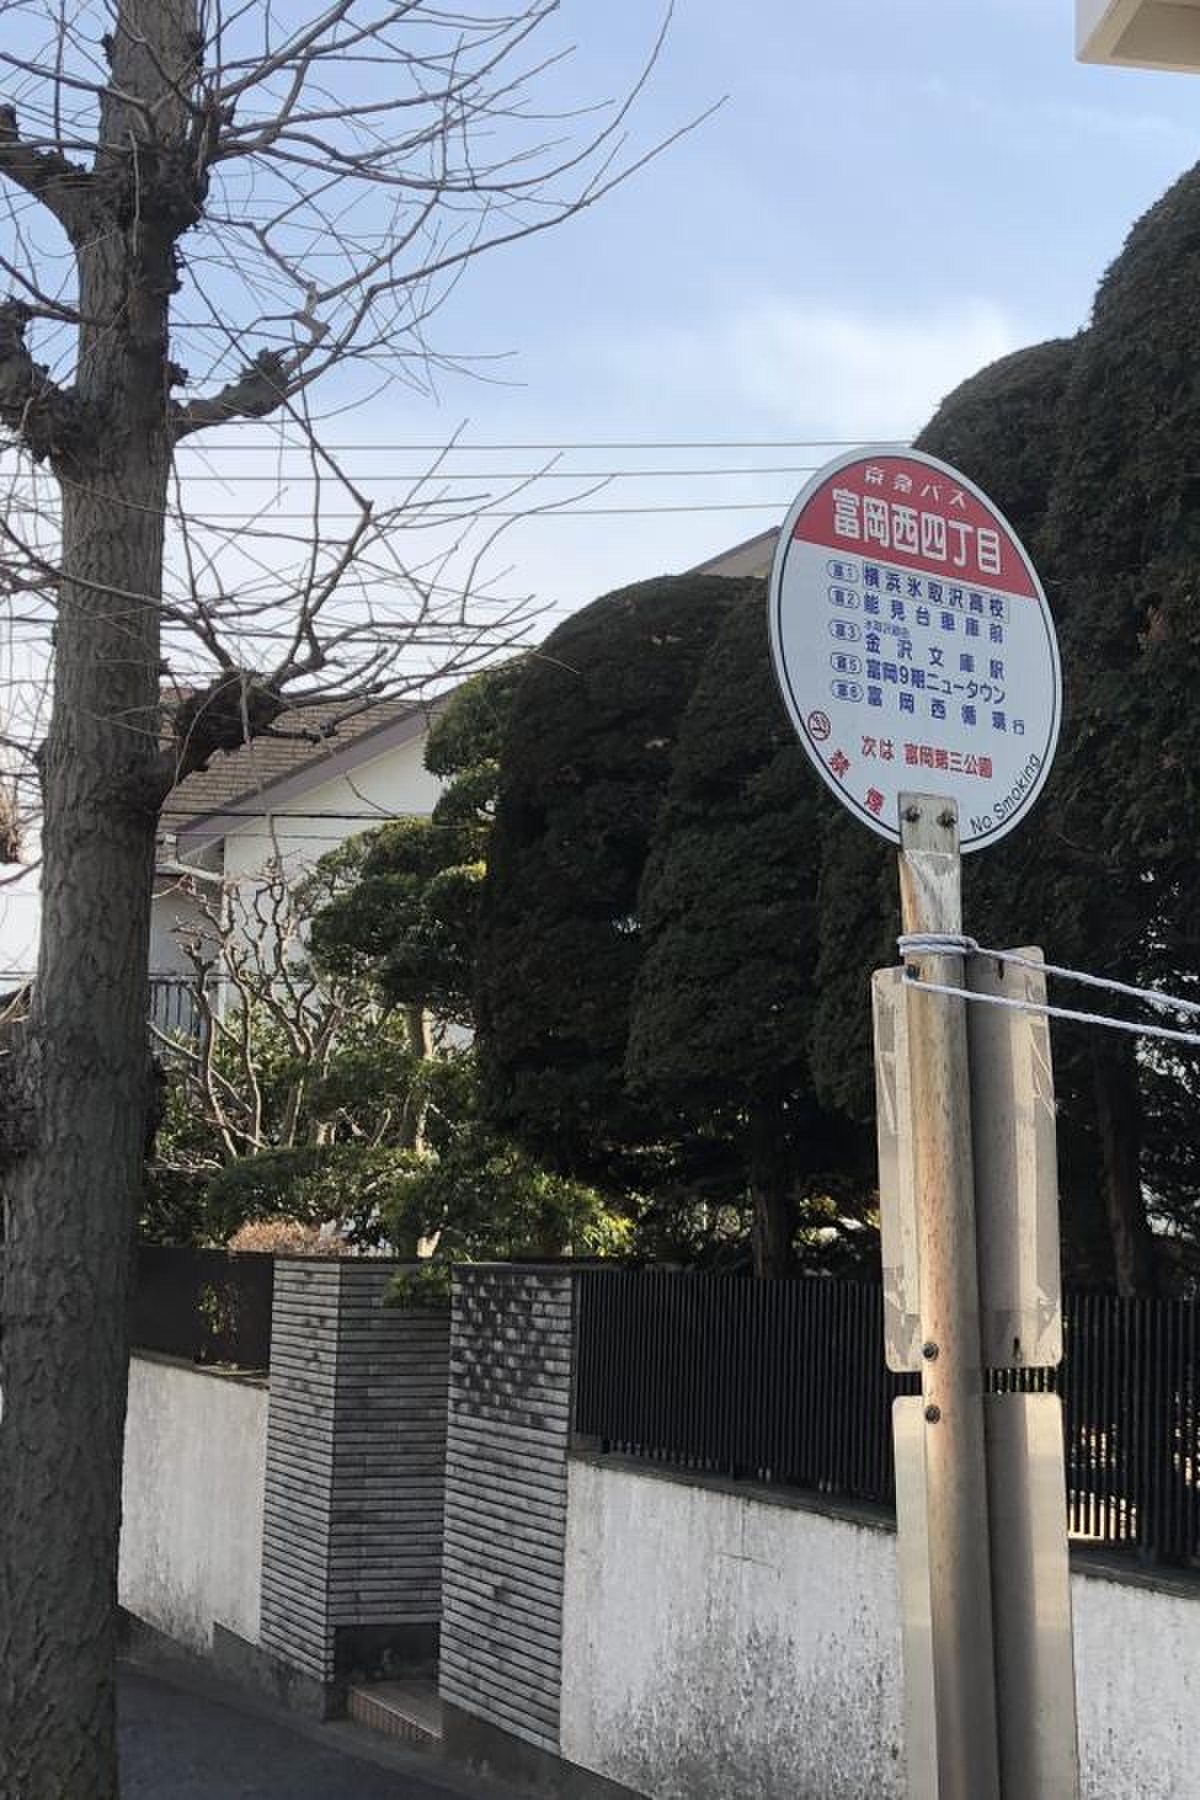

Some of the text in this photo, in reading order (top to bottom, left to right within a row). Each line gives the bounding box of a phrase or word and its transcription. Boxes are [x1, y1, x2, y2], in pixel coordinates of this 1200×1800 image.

[864, 465, 969, 509] 京急バス
[831, 487, 1001, 576] 富岡西四丁目
[863, 566, 1004, 620] 横浜氷取沢高校
[863, 593, 1004, 643] 能見台車庫前
[865, 632, 1005, 681] 金沢文庫駅
[866, 658, 1006, 704] 富岡9期ニュータウン
[969, 752, 1041, 834] No Smoking
